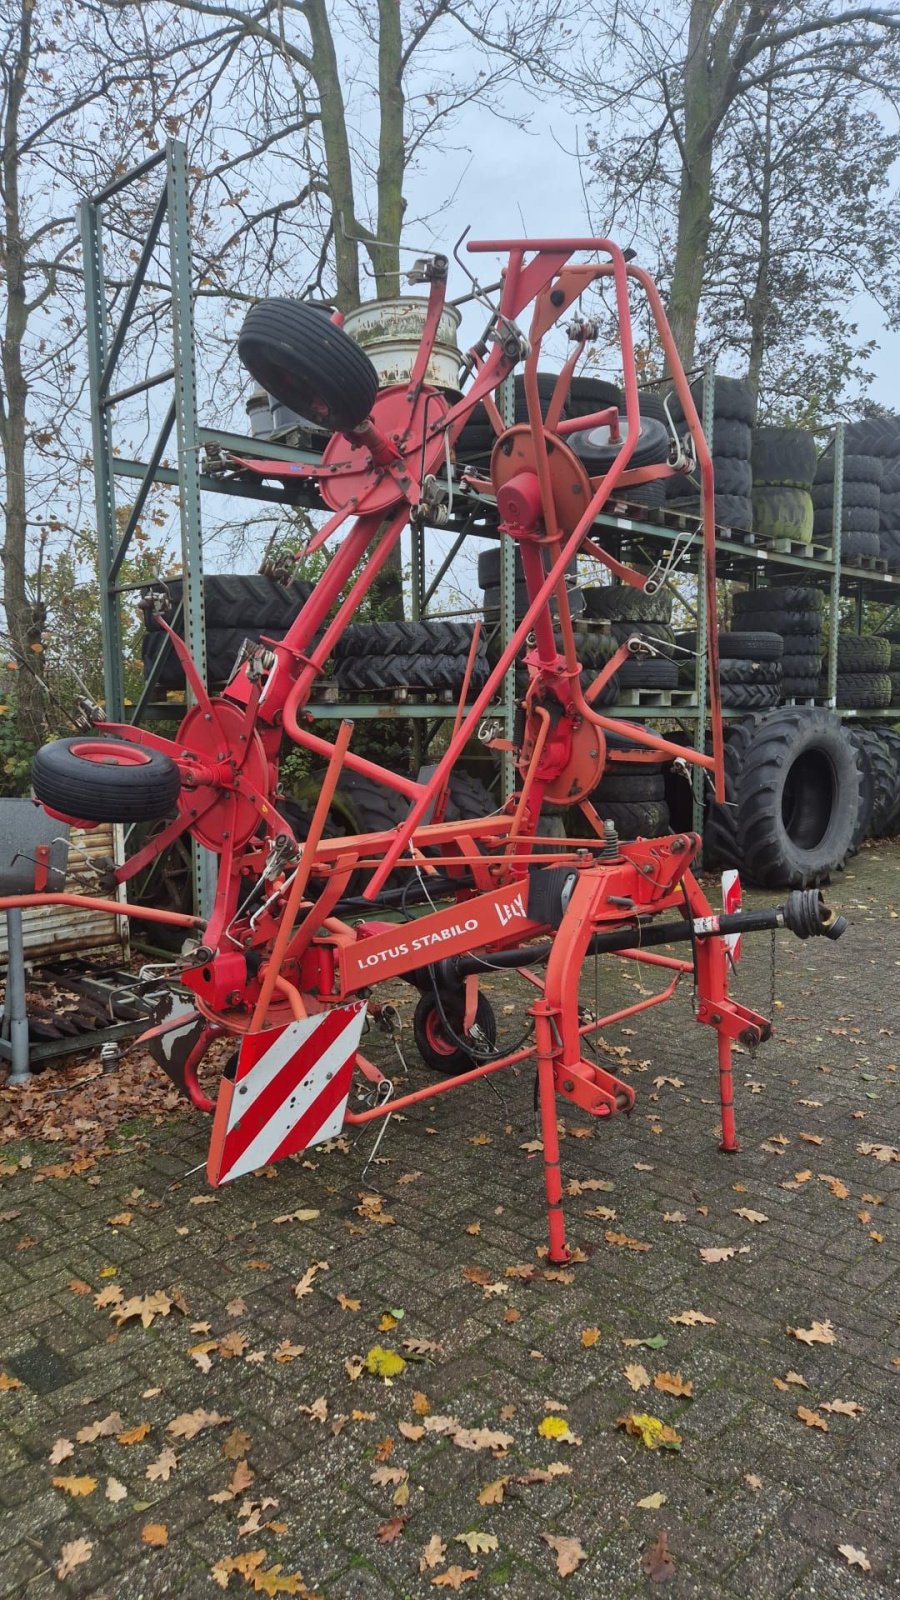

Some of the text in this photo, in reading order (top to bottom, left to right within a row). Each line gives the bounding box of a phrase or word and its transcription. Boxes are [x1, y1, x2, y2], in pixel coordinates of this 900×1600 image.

[494, 893, 527, 927] LELY
[357, 919, 479, 969] LOTUS STABILO
